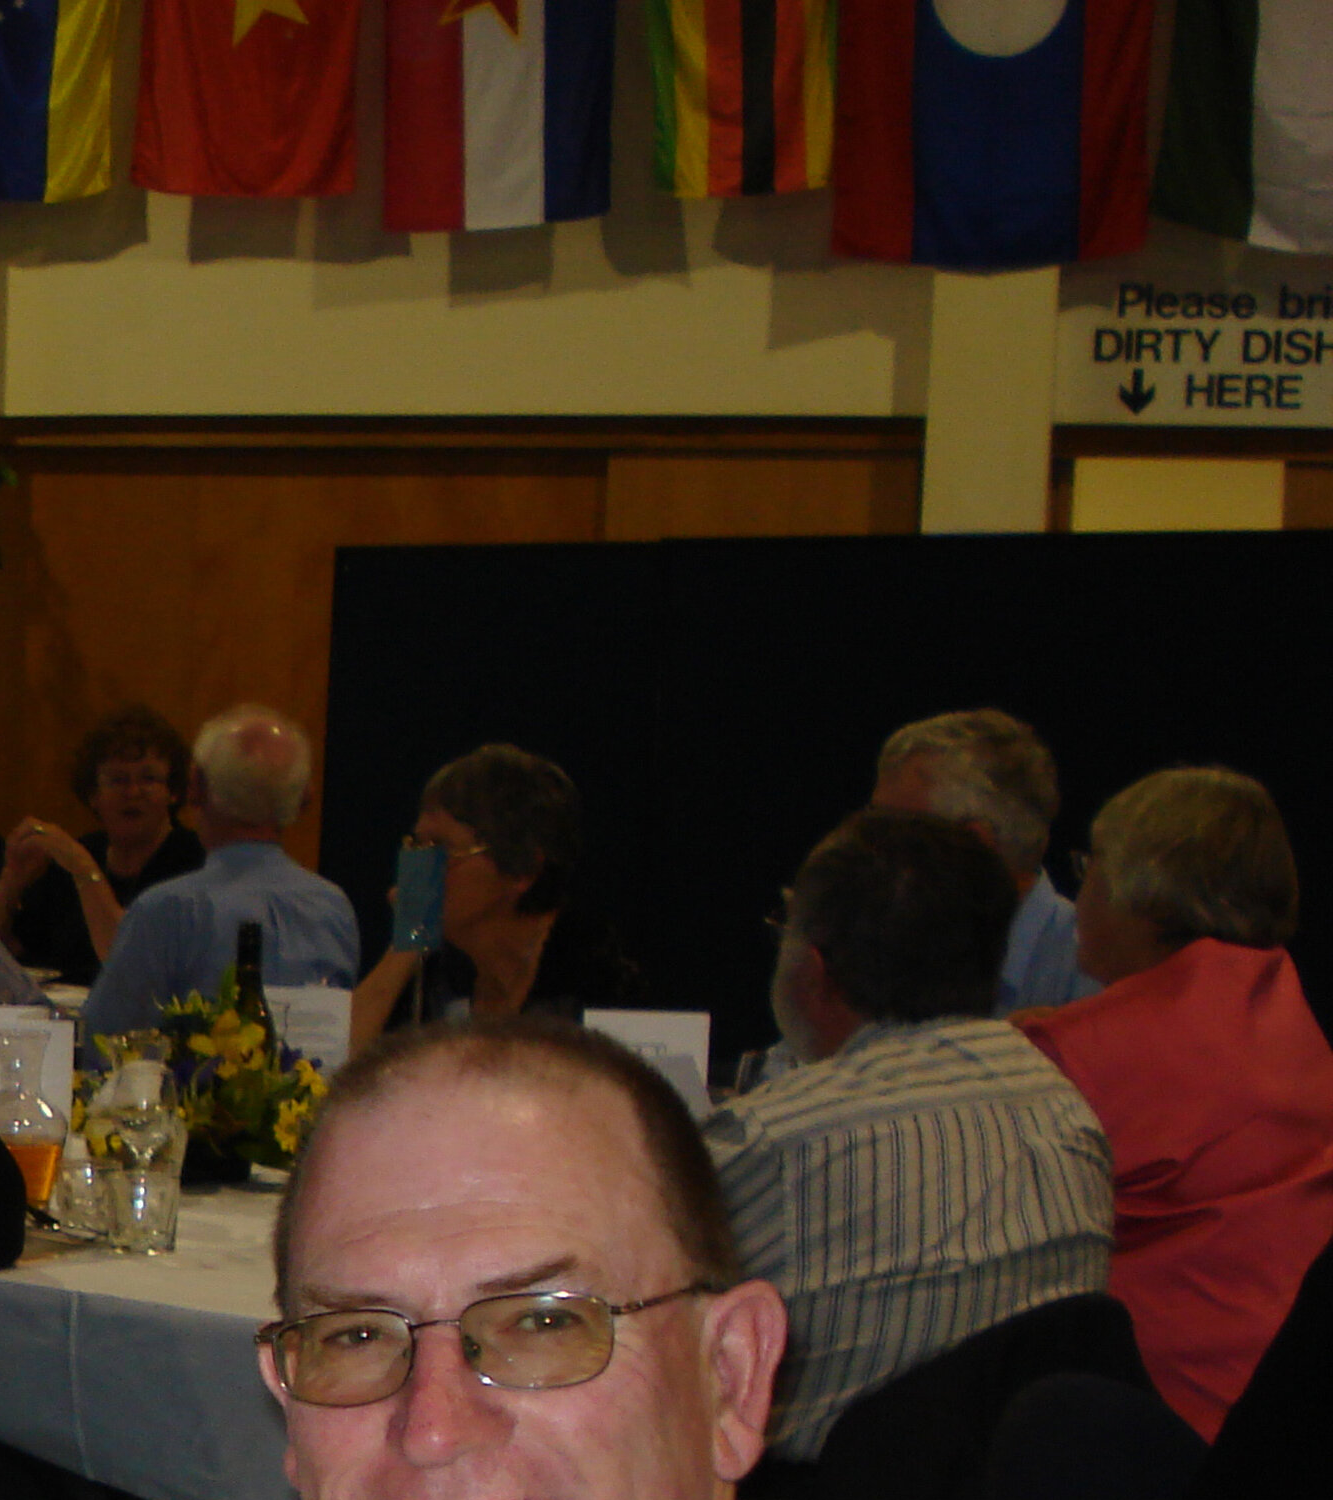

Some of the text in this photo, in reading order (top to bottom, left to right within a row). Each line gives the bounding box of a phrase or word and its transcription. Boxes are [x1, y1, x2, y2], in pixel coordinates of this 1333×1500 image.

[1119, 283, 1257, 319] Please
[1094, 328, 1221, 363] DIRTY
[1185, 373, 1303, 409] HERE
